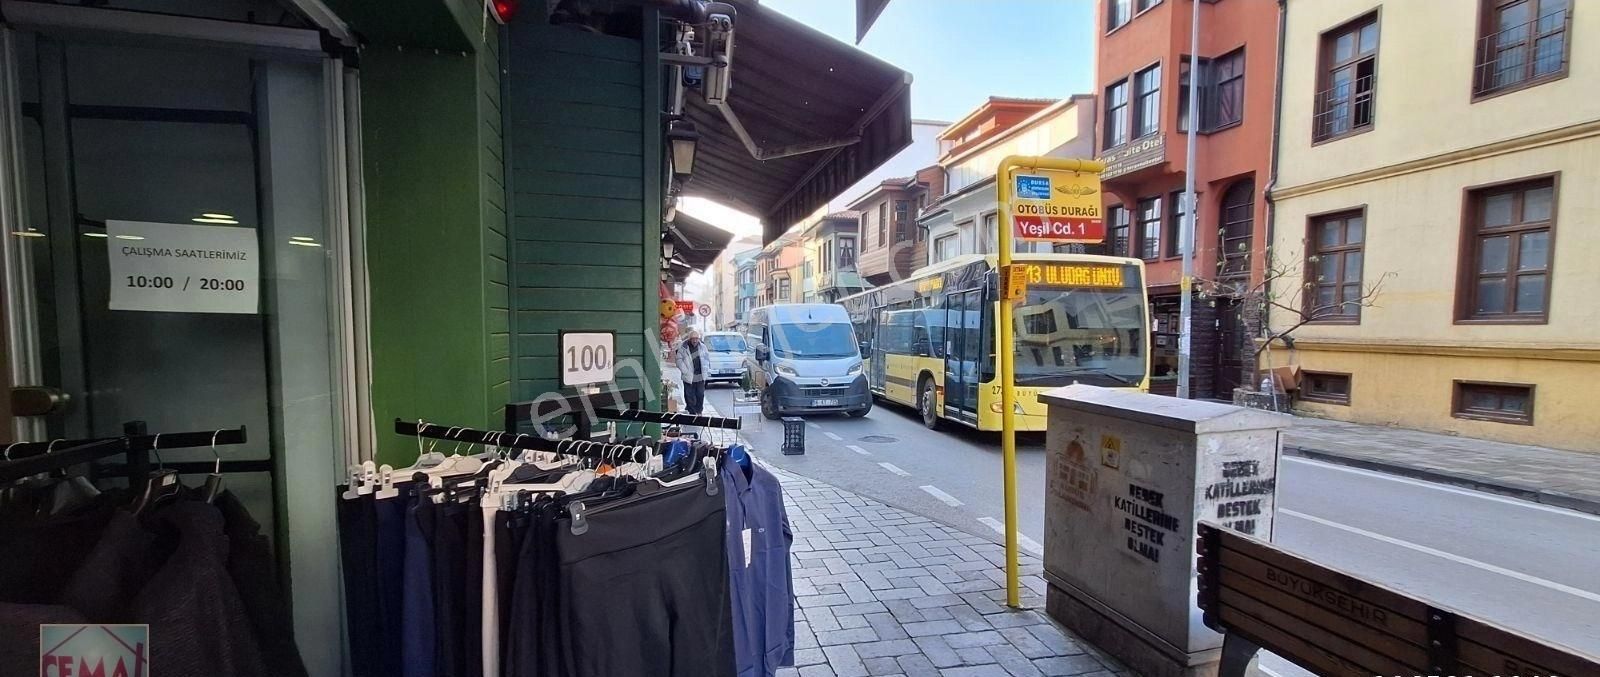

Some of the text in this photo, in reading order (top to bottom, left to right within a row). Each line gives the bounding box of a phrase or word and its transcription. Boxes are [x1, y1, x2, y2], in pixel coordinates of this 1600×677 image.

[1018, 203, 1098, 217] OTOBÜS DURAĞI
[1020, 221, 1085, 237] Yeşil Cd. 1
[122, 246, 247, 261] ÇALIŞMA SAATLERİMİZ
[127, 275, 245, 291] 10:00 / 20:00
